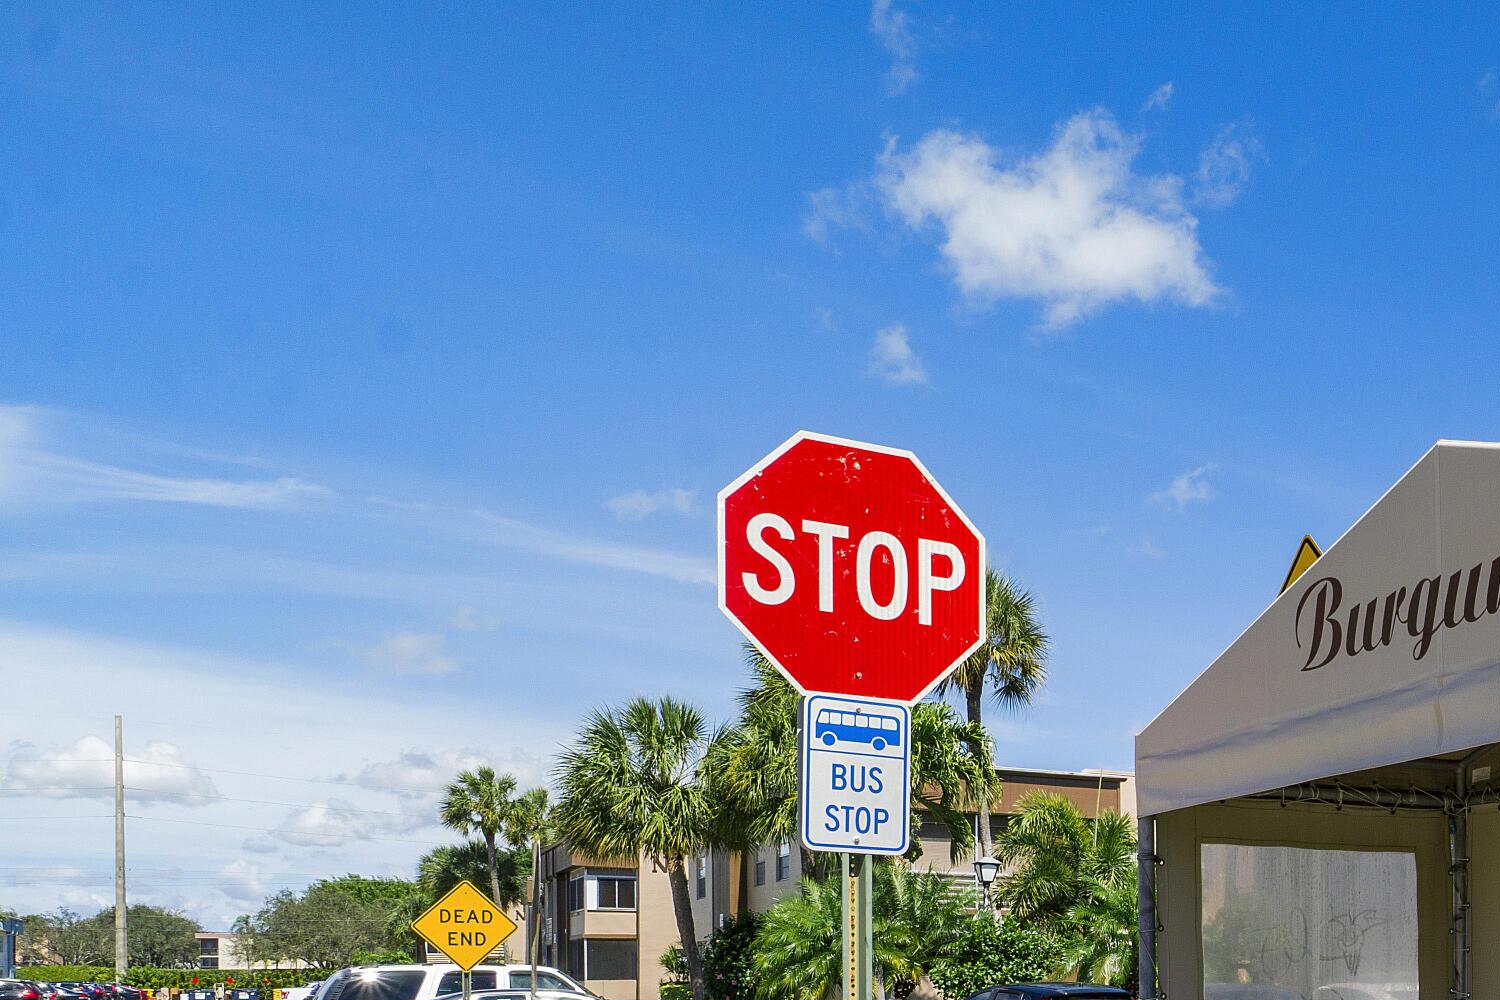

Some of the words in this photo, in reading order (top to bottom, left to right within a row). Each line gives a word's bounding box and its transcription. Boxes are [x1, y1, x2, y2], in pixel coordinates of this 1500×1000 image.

[742, 513, 966, 626] STOP
[832, 764, 883, 794] BUS
[824, 804, 889, 835] STOP
[439, 909, 493, 924] DEAD
[447, 931, 487, 946] END
